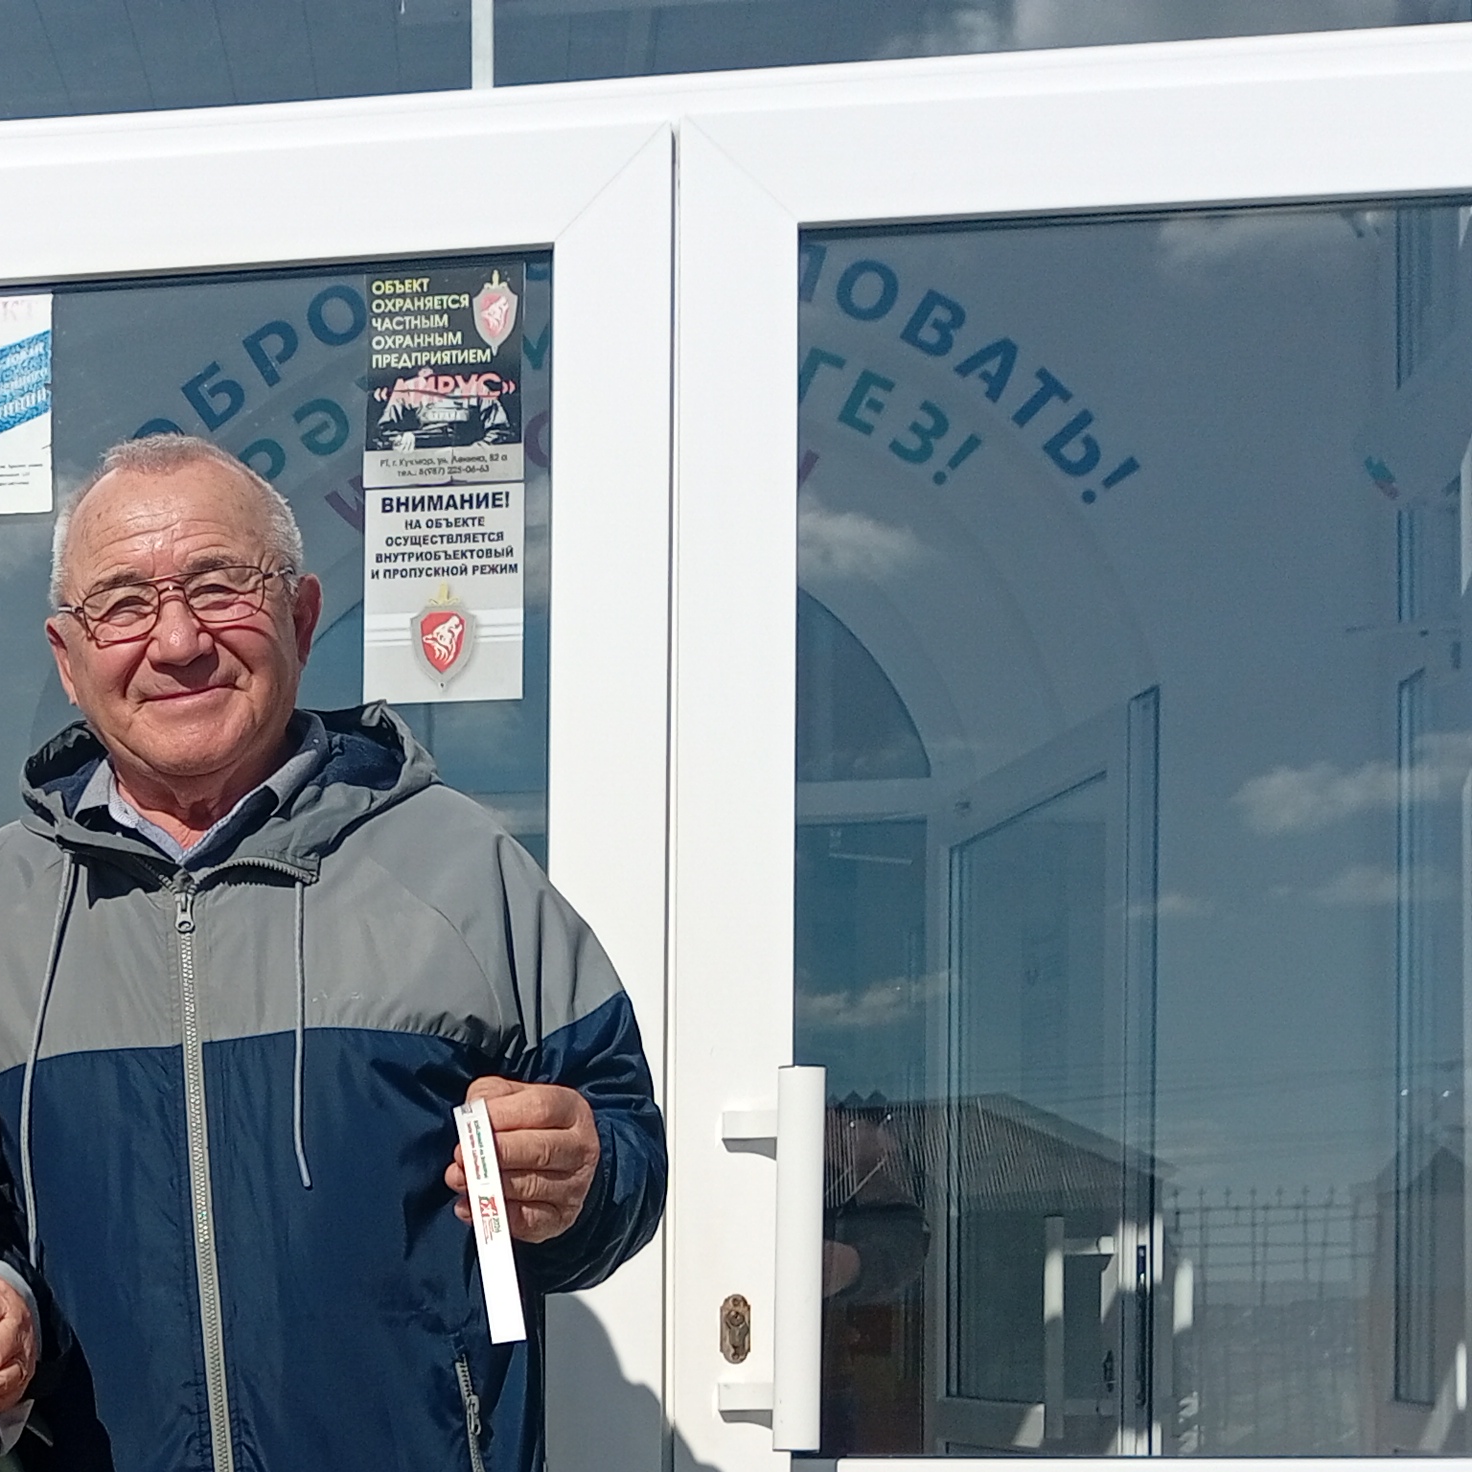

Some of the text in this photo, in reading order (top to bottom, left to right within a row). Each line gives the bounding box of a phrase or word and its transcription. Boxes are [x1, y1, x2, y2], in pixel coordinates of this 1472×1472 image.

[372, 278, 430, 295] ОБЪЕКТ
[372, 294, 469, 313] ОХРАНЯЕТСЯ
[372, 314, 448, 331] ЧАСТНЫМ
[372, 331, 462, 350] ОХРАННЫМ
[372, 348, 491, 369] ПРЕДПРИЯТИЕМ
[381, 491, 509, 513] ВНИМАНИЕ!
[405, 516, 485, 530] НА ОБЪЕКТЕ
[385, 531, 504, 547] ОСУЩЕСТВЛЯЕТСЯ
[375, 545, 514, 563] ВНУТРИОБЪЕКТОВЫЙ
[371, 563, 518, 579] И ПРОПУСКНОЙ РЕЖИМ
